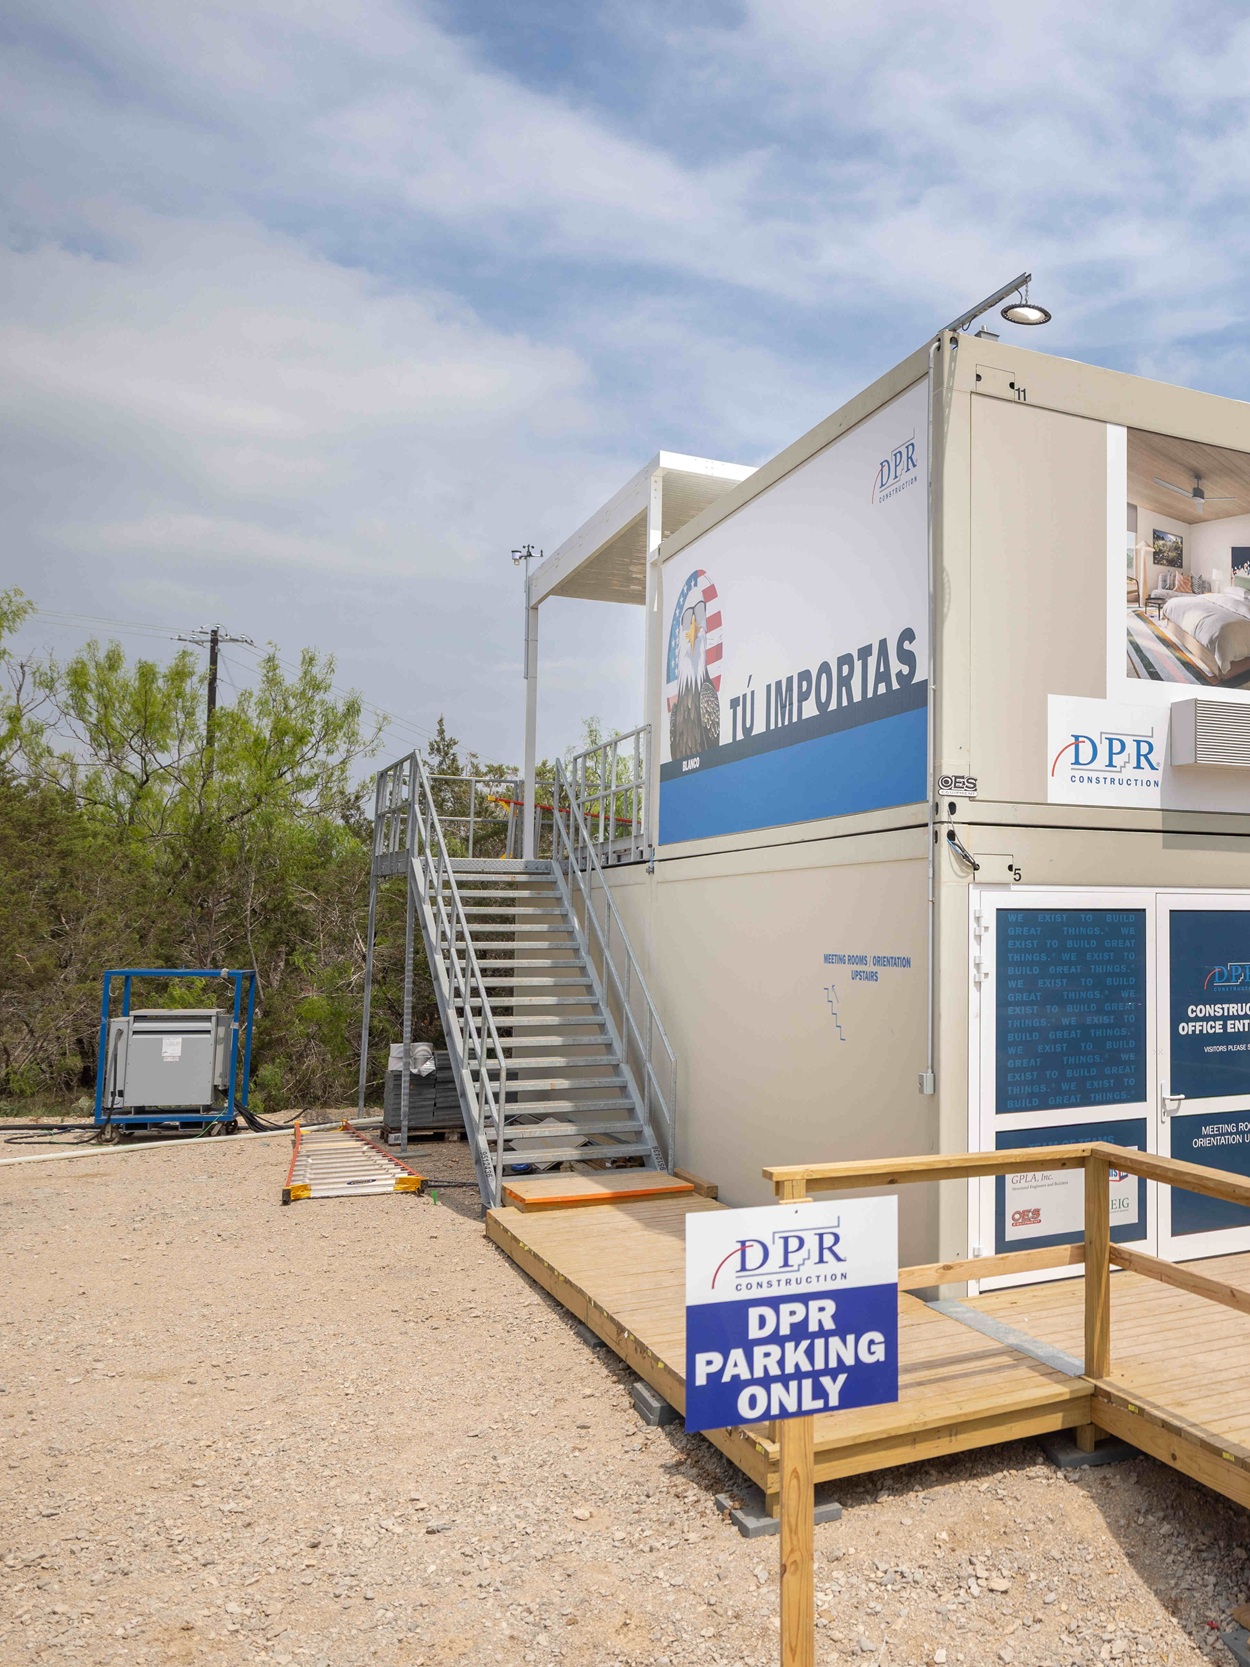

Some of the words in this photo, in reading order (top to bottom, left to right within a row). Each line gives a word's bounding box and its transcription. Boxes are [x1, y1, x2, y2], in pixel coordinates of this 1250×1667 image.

[1015, 388, 1026, 401] 11
[879, 442, 917, 489] DPR
[879, 476, 918, 504] CONSTRUCTION
[730, 674, 755, 743] TÚ
[766, 627, 917, 732] IMPORTAS
[1070, 734, 1159, 770] DPR
[1070, 775, 1159, 788] CONSTRUCTION
[1014, 868, 1021, 882] 5
[1008, 914, 1023, 922] WE
[1038, 914, 1067, 922] EXIST
[1081, 914, 1092, 922] TO
[1106, 914, 1135, 922] BUILD
[1008, 927, 1041, 935] GREAT
[1008, 940, 1038, 948] EXIST
[1046, 940, 1058, 948] TO
[1067, 940, 1096, 948] BUILD
[824, 954, 846, 965] MEETING
[847, 955, 868, 966] ROOMS
[873, 956, 911, 968] ORIENTATION
[1087, 952, 1114, 960] EXIST
[1124, 952, 1135, 960] TO
[851, 970, 878, 982] UPSTAIRS
[1008, 966, 1039, 974] BUILD
[1008, 980, 1023, 988] WE
[1038, 979, 1067, 987] EXIST
[1081, 978, 1092, 986] TO
[1008, 993, 1041, 1001] GREAT
[1008, 1006, 1038, 1014] EXIST
[1046, 1005, 1058, 1013] TO
[1067, 1004, 1096, 1012] BUILD
[1062, 1018, 1076, 1026] WE
[1087, 1016, 1114, 1024] EXIST
[1178, 1021, 1223, 1035] OFFICE
[1008, 1032, 1039, 1041] BUILD
[1049, 1030, 1081, 1039] GREAT
[1008, 1046, 1023, 1055] WE
[1038, 1044, 1067, 1052] EXIST
[1081, 1042, 1092, 1050] TO
[1106, 1040, 1135, 1049] BUILD
[1008, 1058, 1041, 1068] GREAT
[1008, 1072, 1038, 1081] EXIST
[1067, 1068, 1096, 1077] BUILD
[1105, 1066, 1135, 1075] GREAT
[1062, 1082, 1076, 1090] WE
[1087, 1080, 1114, 1089] EXIST
[1124, 1078, 1135, 1086] TO
[1008, 1098, 1039, 1108] BUILD
[1049, 1095, 1081, 1105] GREAT
[1202, 1123, 1236, 1135] MEETING
[1192, 1134, 1242, 1148] ORIENTATION
[1011, 1174, 1039, 1184] GPLA,
[1041, 1173, 1053, 1181] Inc.
[736, 1231, 847, 1273] DPR
[735, 1272, 847, 1292] CONSTRUCTION
[748, 1298, 836, 1340] DPR
[695, 1331, 885, 1386] PARKING
[737, 1373, 848, 1419] ONLY
